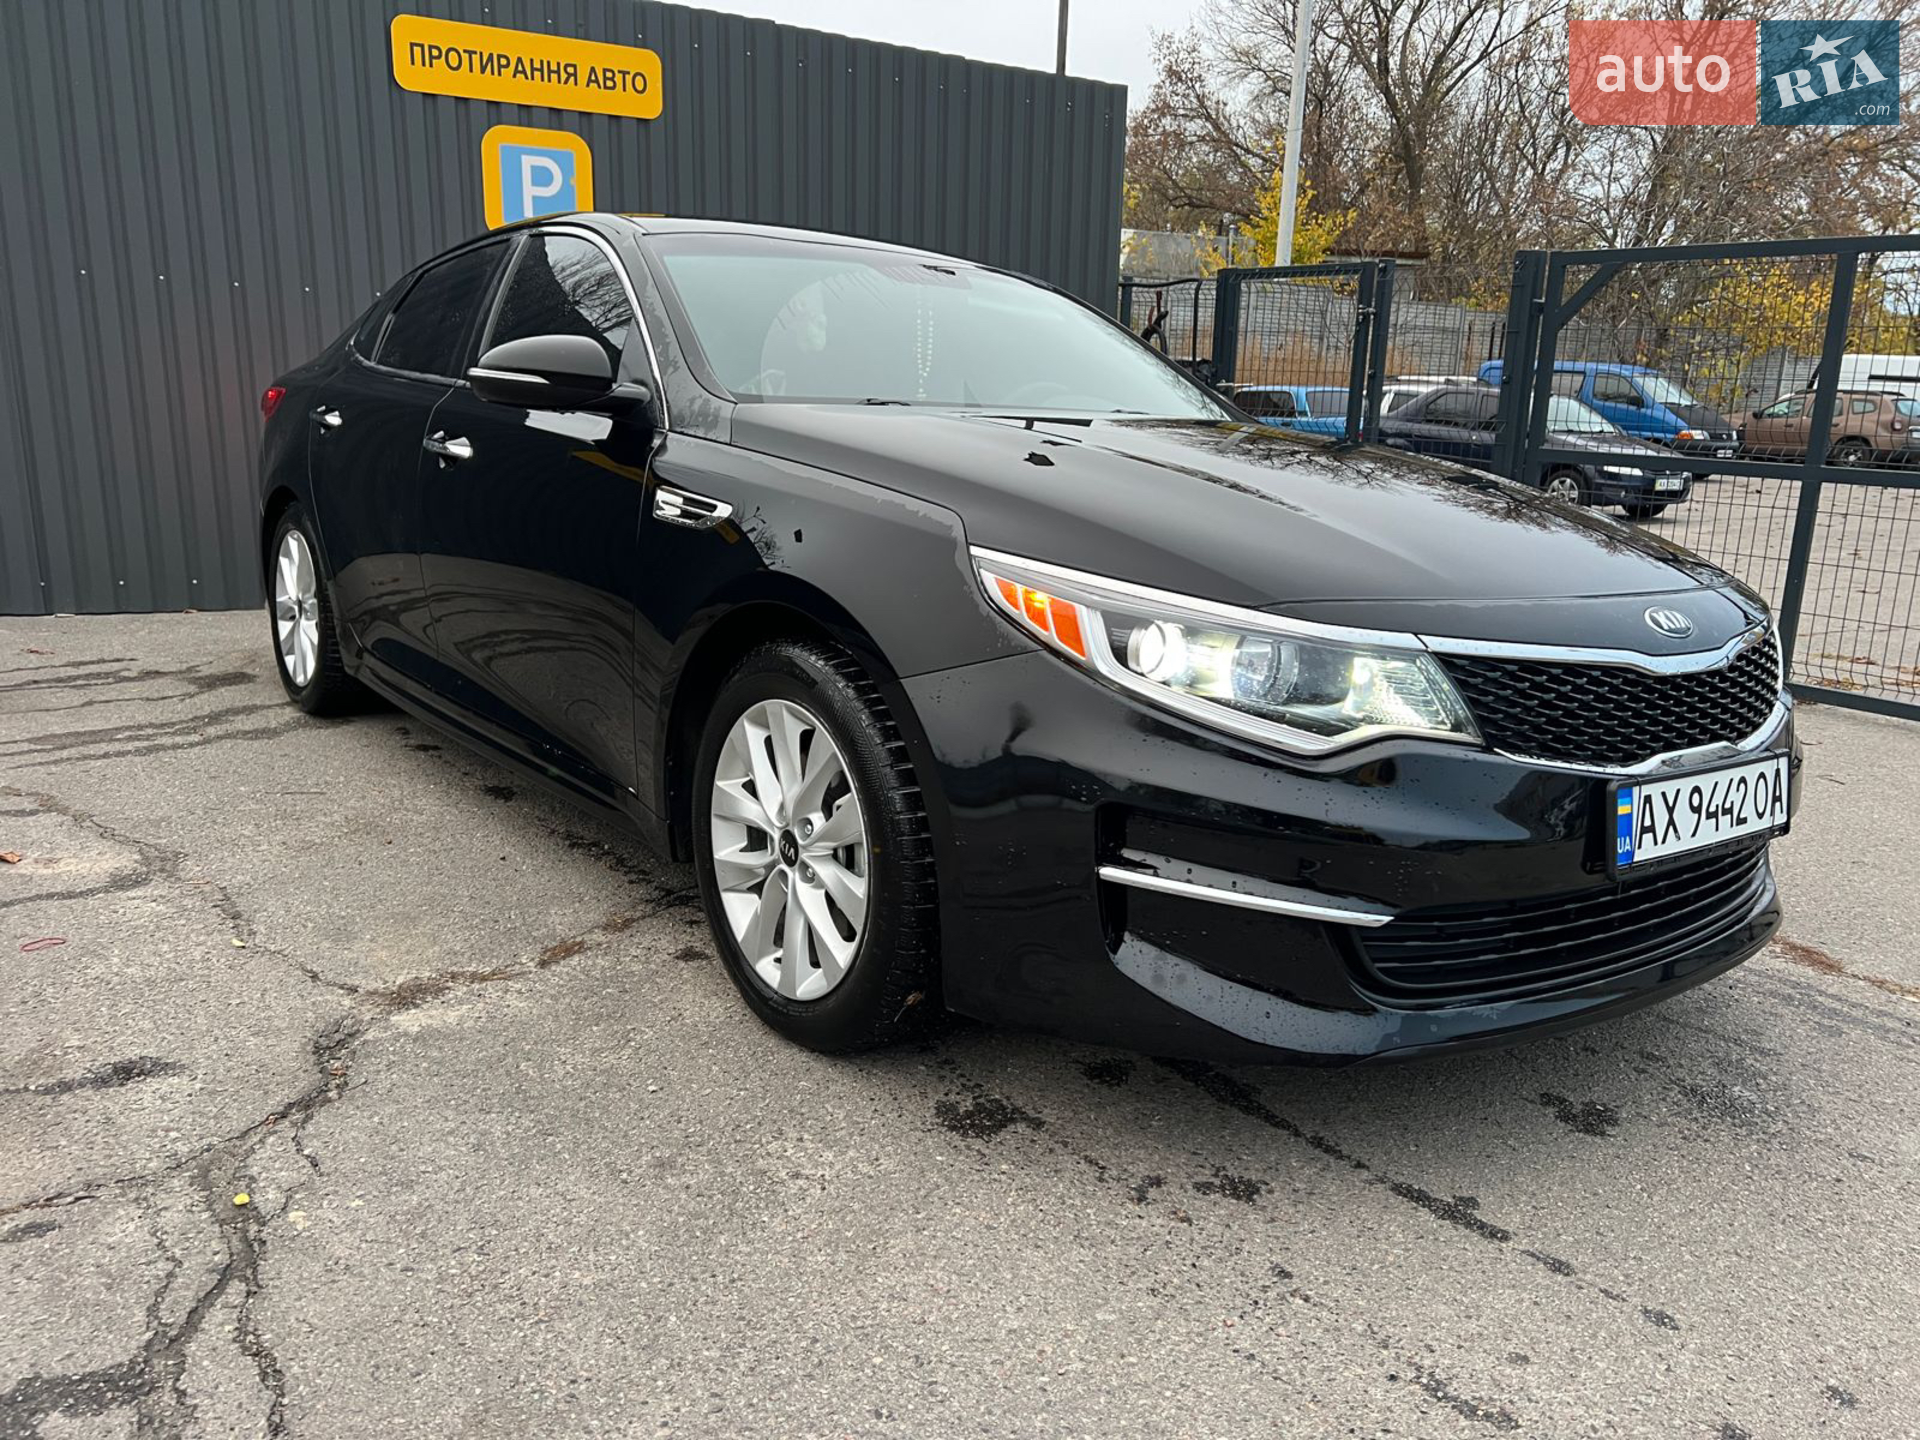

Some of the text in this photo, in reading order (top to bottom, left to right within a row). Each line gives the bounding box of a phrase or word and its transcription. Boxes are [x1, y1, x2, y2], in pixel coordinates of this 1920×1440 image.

[408, 41, 648, 95] ПРОТИРАННЯ АВТО
[521, 154, 563, 218] P
[1651, 610, 1691, 630] KIA
[1637, 767, 1784, 851] AX 9442 OA
[780, 838, 795, 860] KIA
[1617, 837, 1632, 853] UA
